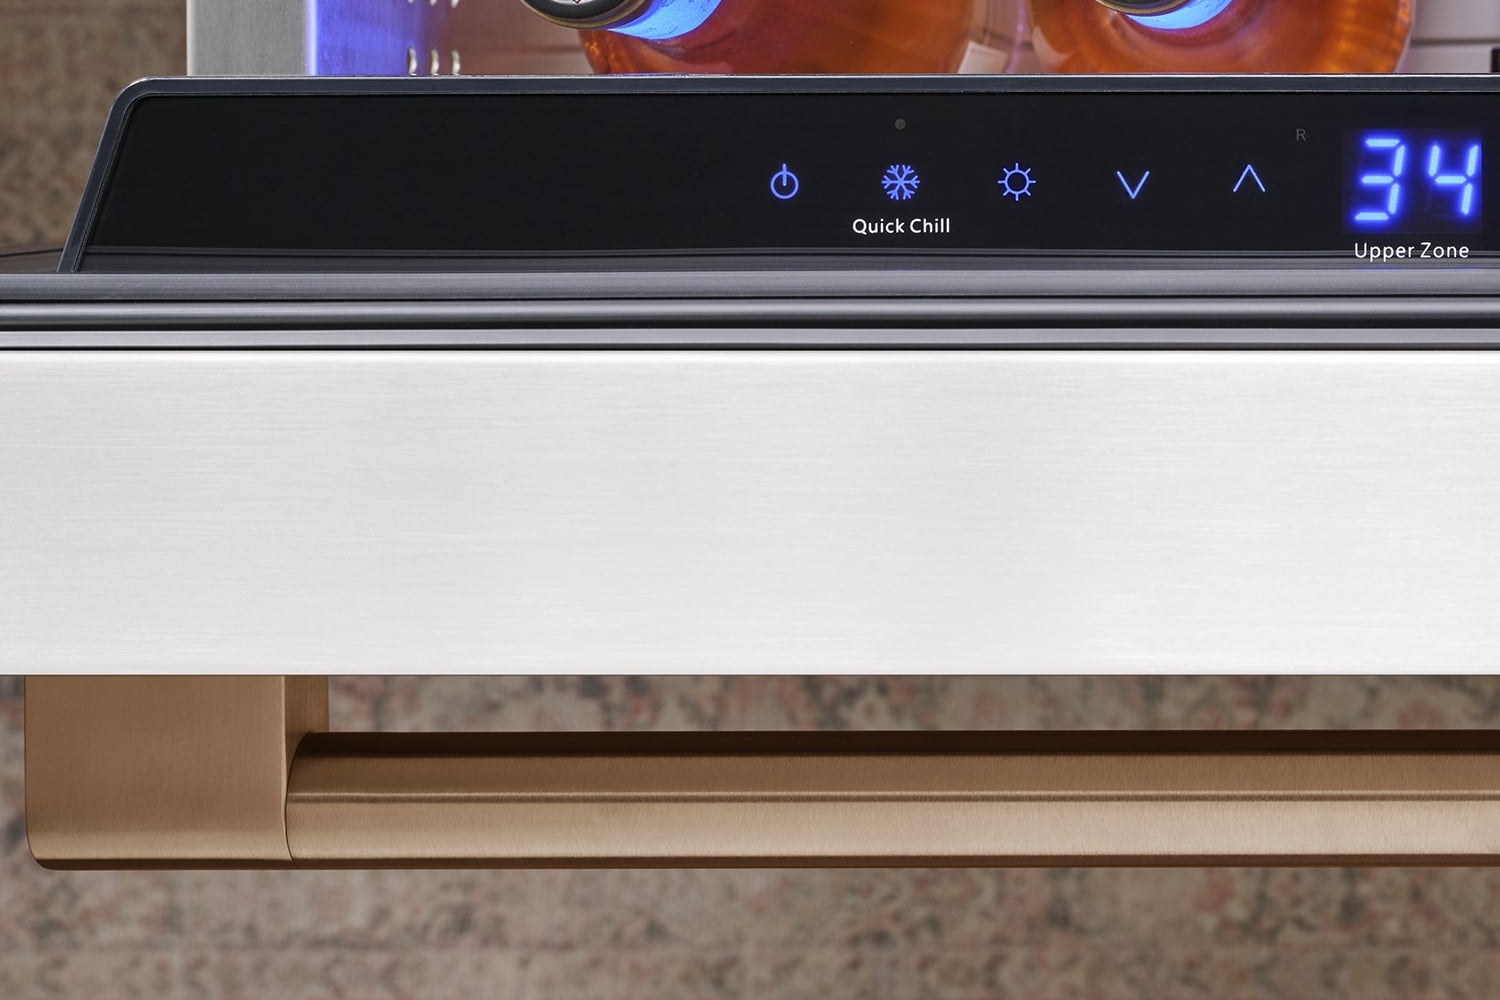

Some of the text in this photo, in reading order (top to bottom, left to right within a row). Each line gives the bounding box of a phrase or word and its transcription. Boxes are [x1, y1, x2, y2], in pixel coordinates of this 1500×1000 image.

[1355, 138, 1478, 222] 34
[852, 217, 950, 236] Quick Chill
[1354, 242, 1469, 262] Upper Zone
